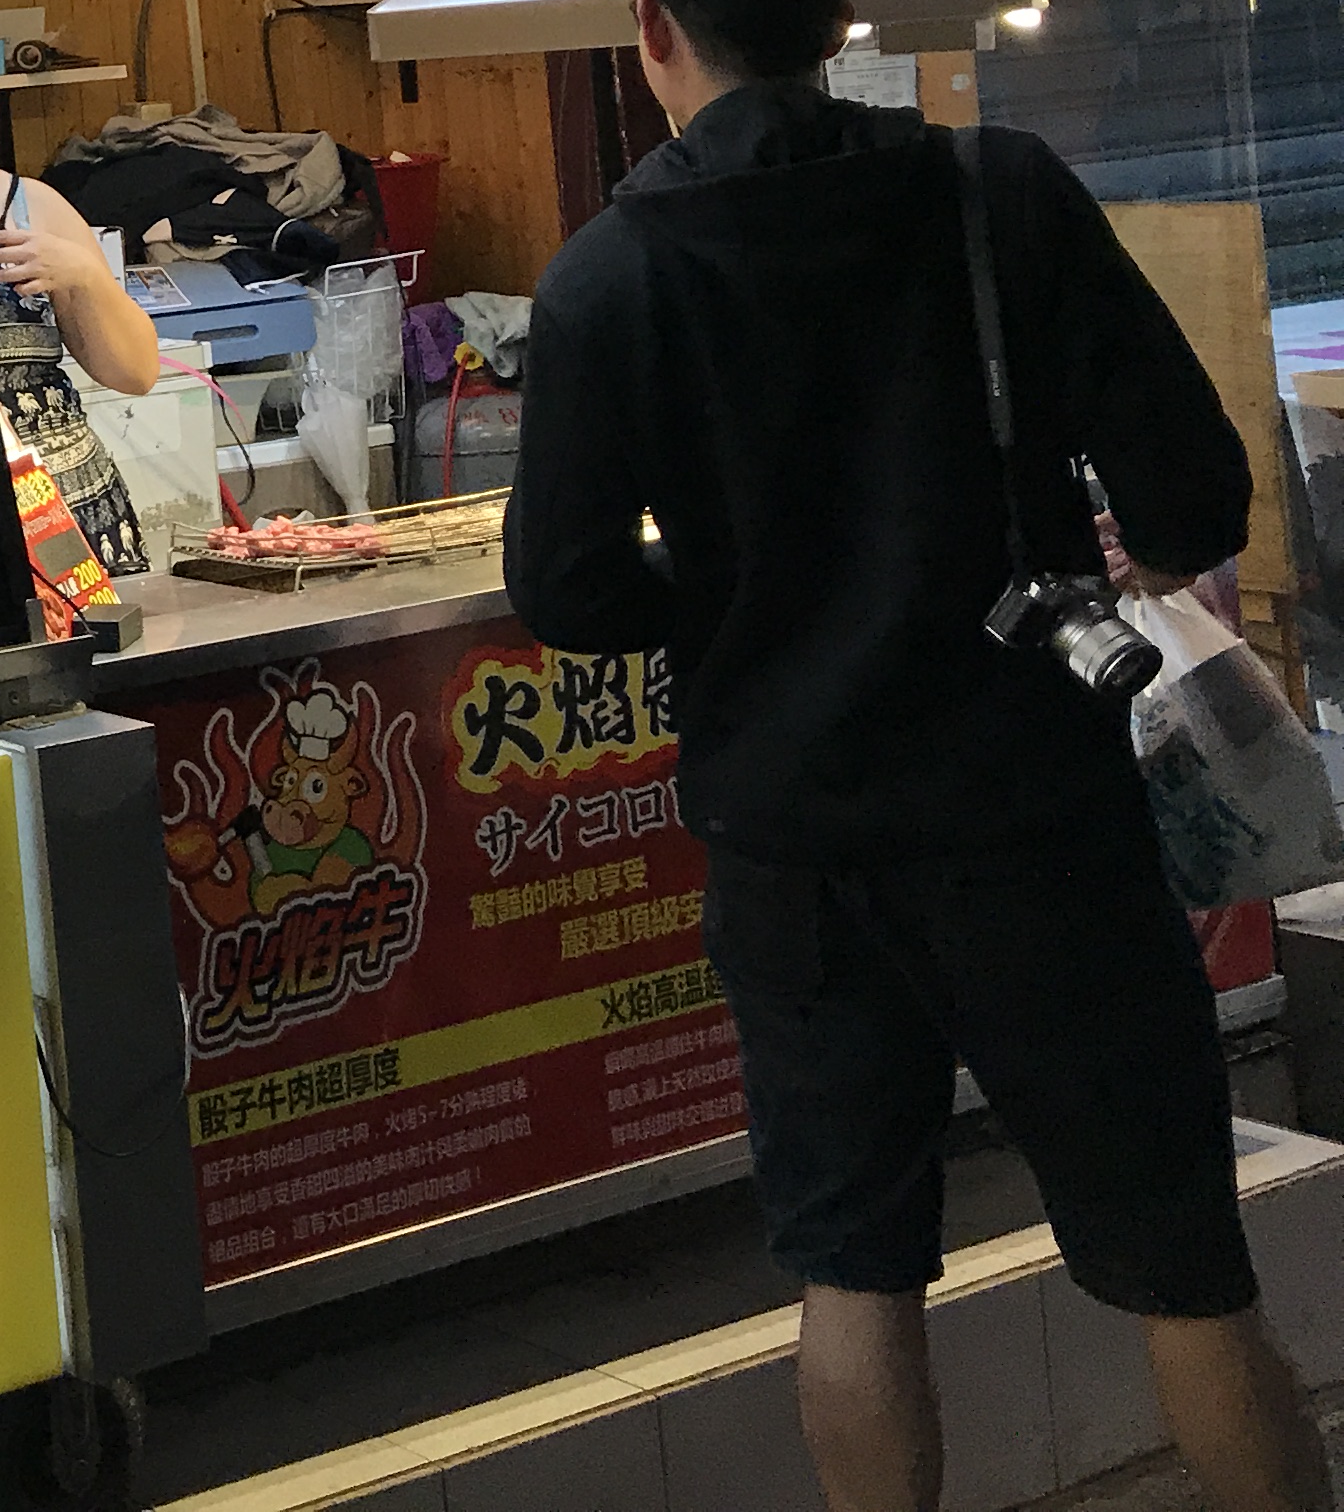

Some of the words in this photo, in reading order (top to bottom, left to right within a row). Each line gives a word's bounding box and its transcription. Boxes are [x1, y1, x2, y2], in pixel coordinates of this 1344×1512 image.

[73, 558, 102, 591] 200
[197, 874, 409, 1033] 火焰牛
